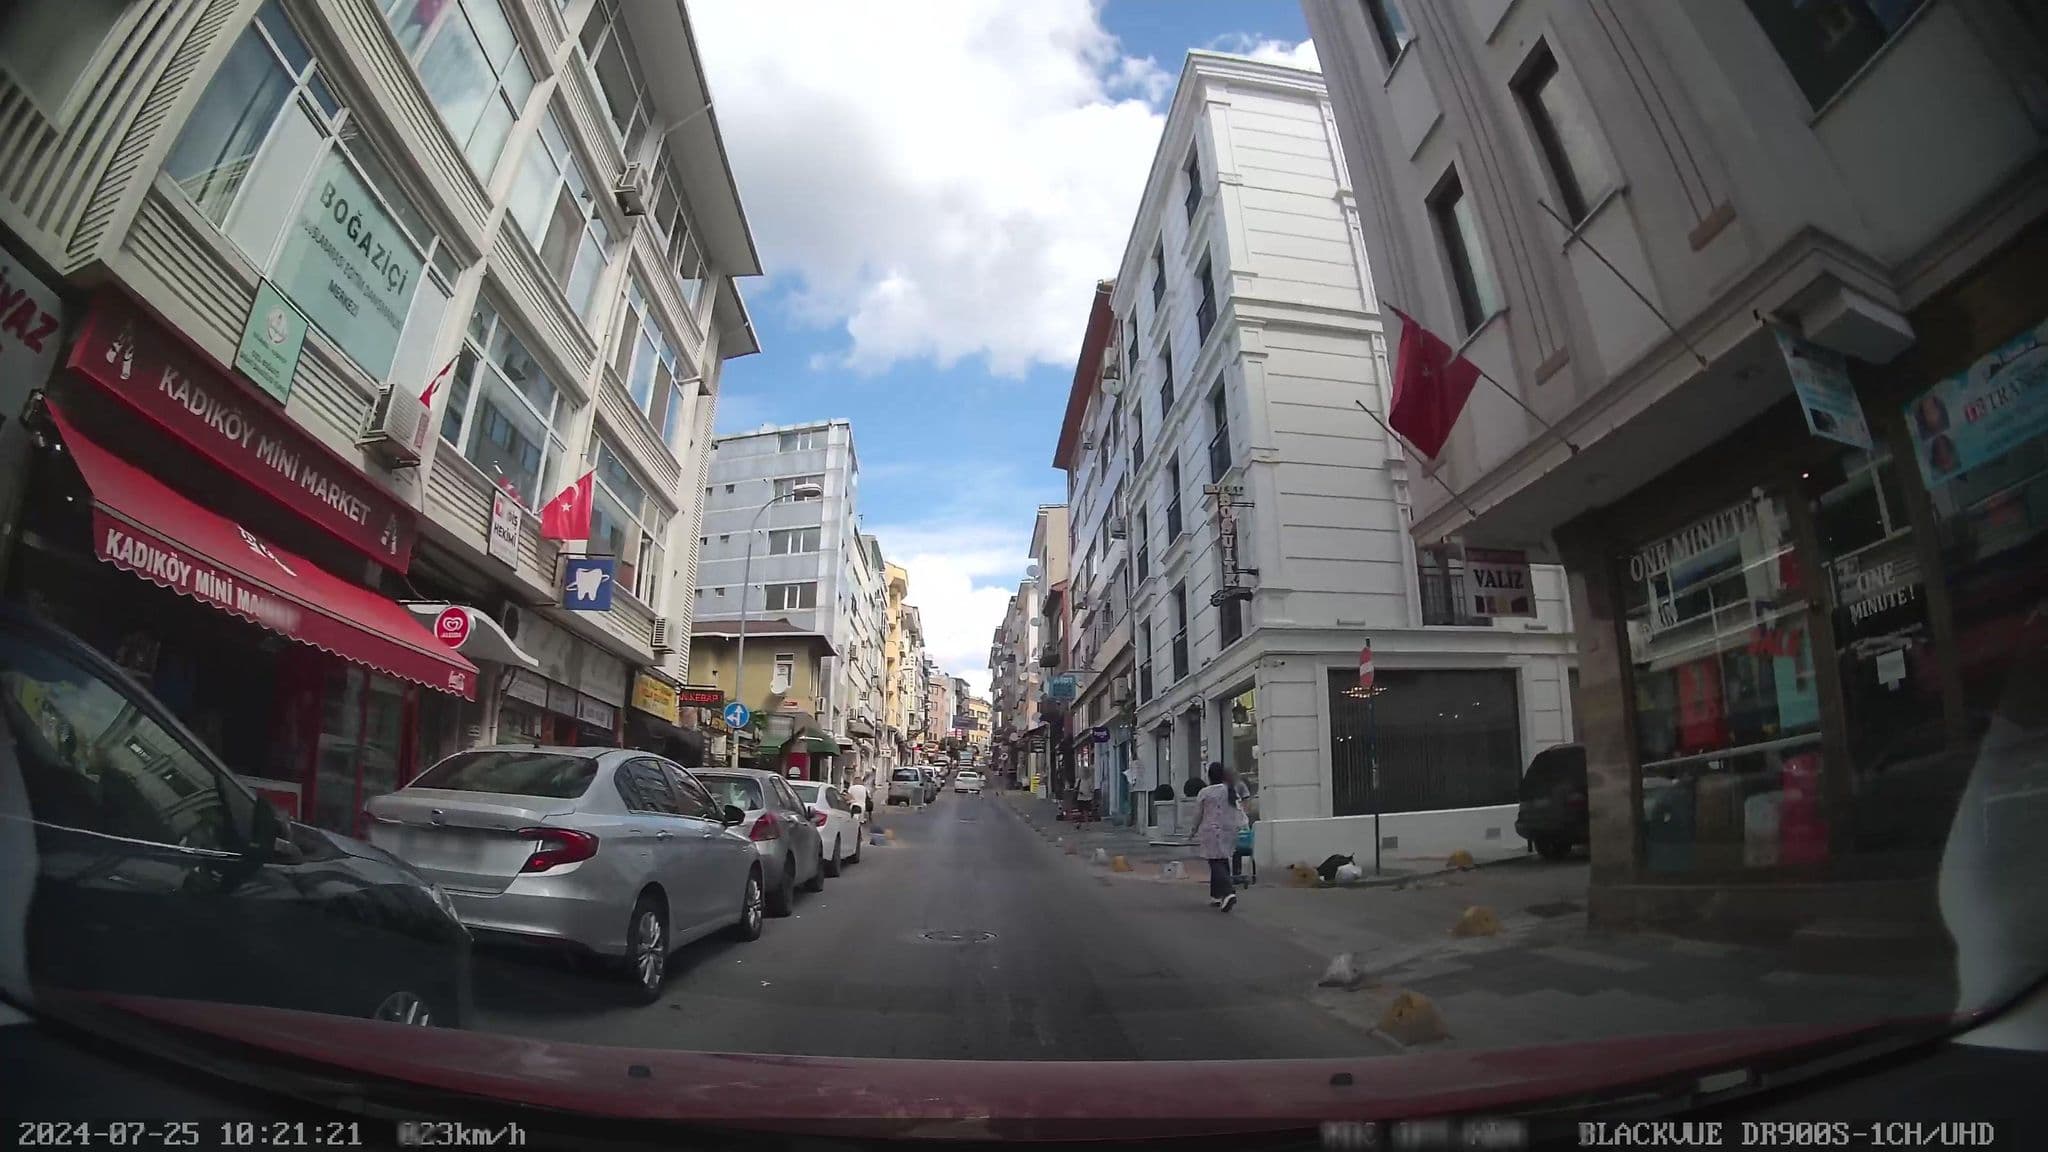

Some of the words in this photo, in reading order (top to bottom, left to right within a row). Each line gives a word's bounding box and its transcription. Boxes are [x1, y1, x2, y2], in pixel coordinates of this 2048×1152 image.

[320, 180, 408, 295] BOĞAZİÇİ
[159, 365, 256, 448] KADIKÖY
[256, 435, 301, 482] MİNİ
[301, 465, 372, 526] MARKET
[106, 528, 192, 587] KADIKÖY
[195, 569, 233, 607] MİNİ
